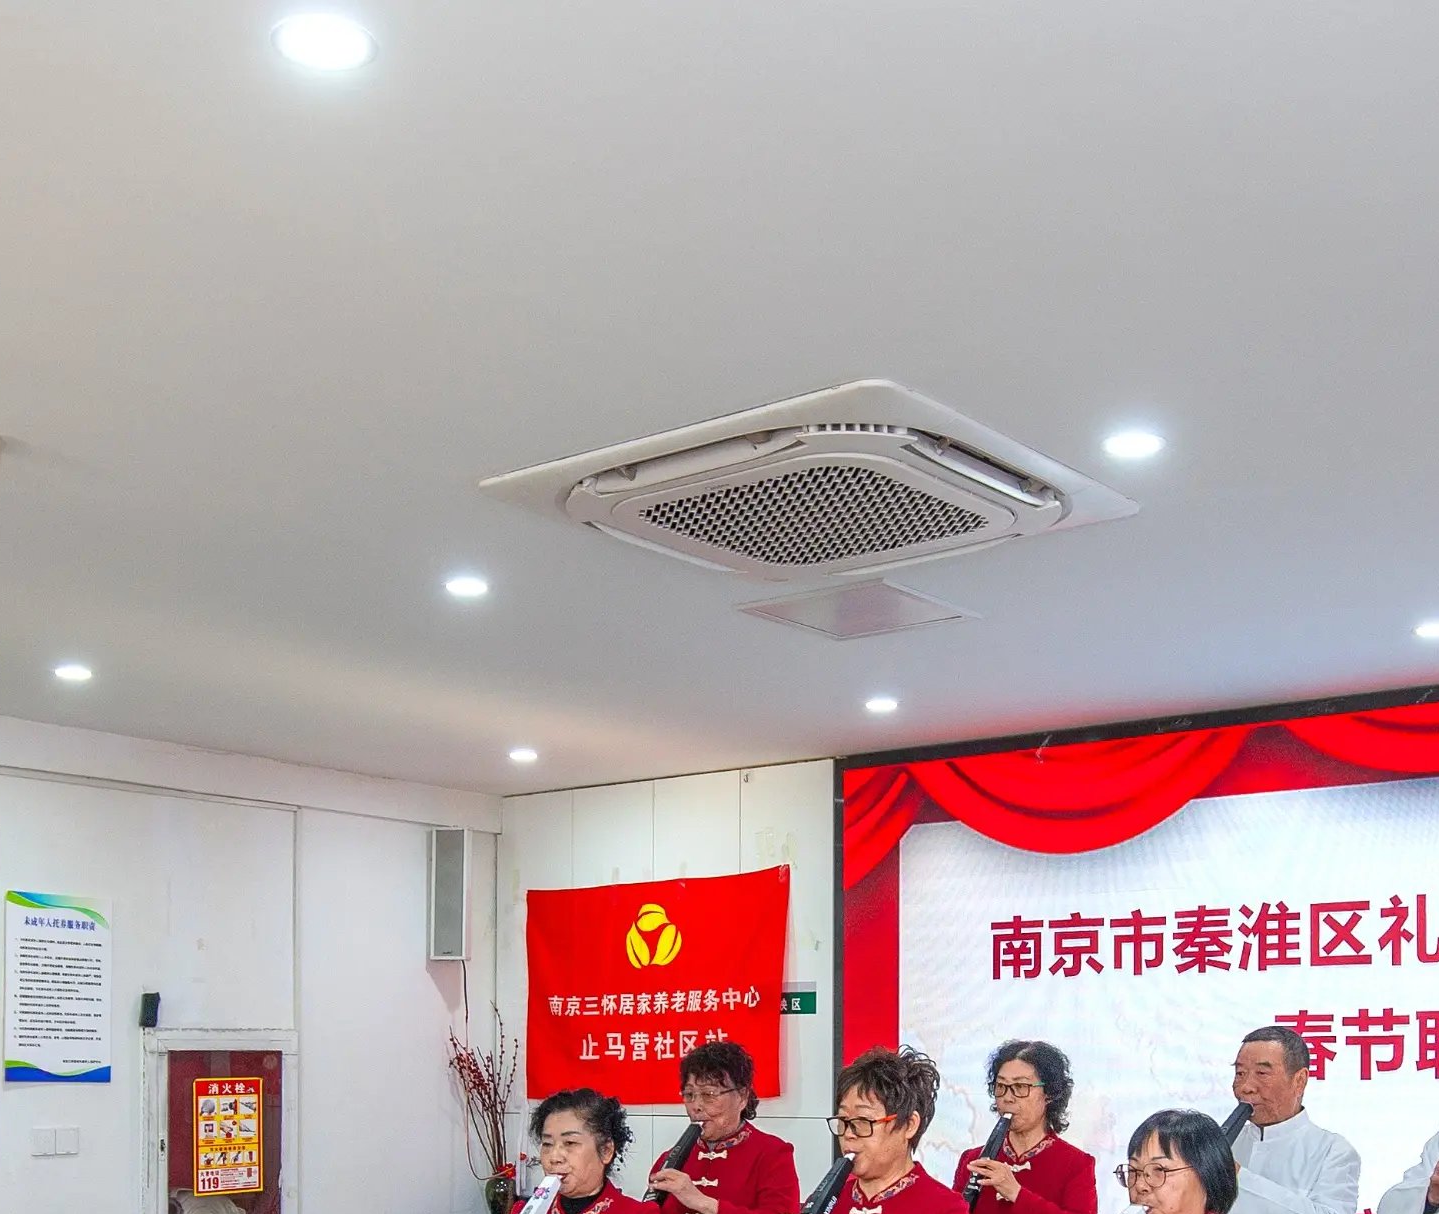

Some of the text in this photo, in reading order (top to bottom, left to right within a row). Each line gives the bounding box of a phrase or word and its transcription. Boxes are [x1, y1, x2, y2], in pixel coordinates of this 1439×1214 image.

[548, 986, 760, 1017] 南京三怀居家养老服务中心
[208, 1082, 245, 1095] 消火栓
[201, 1176, 219, 1190] 119
